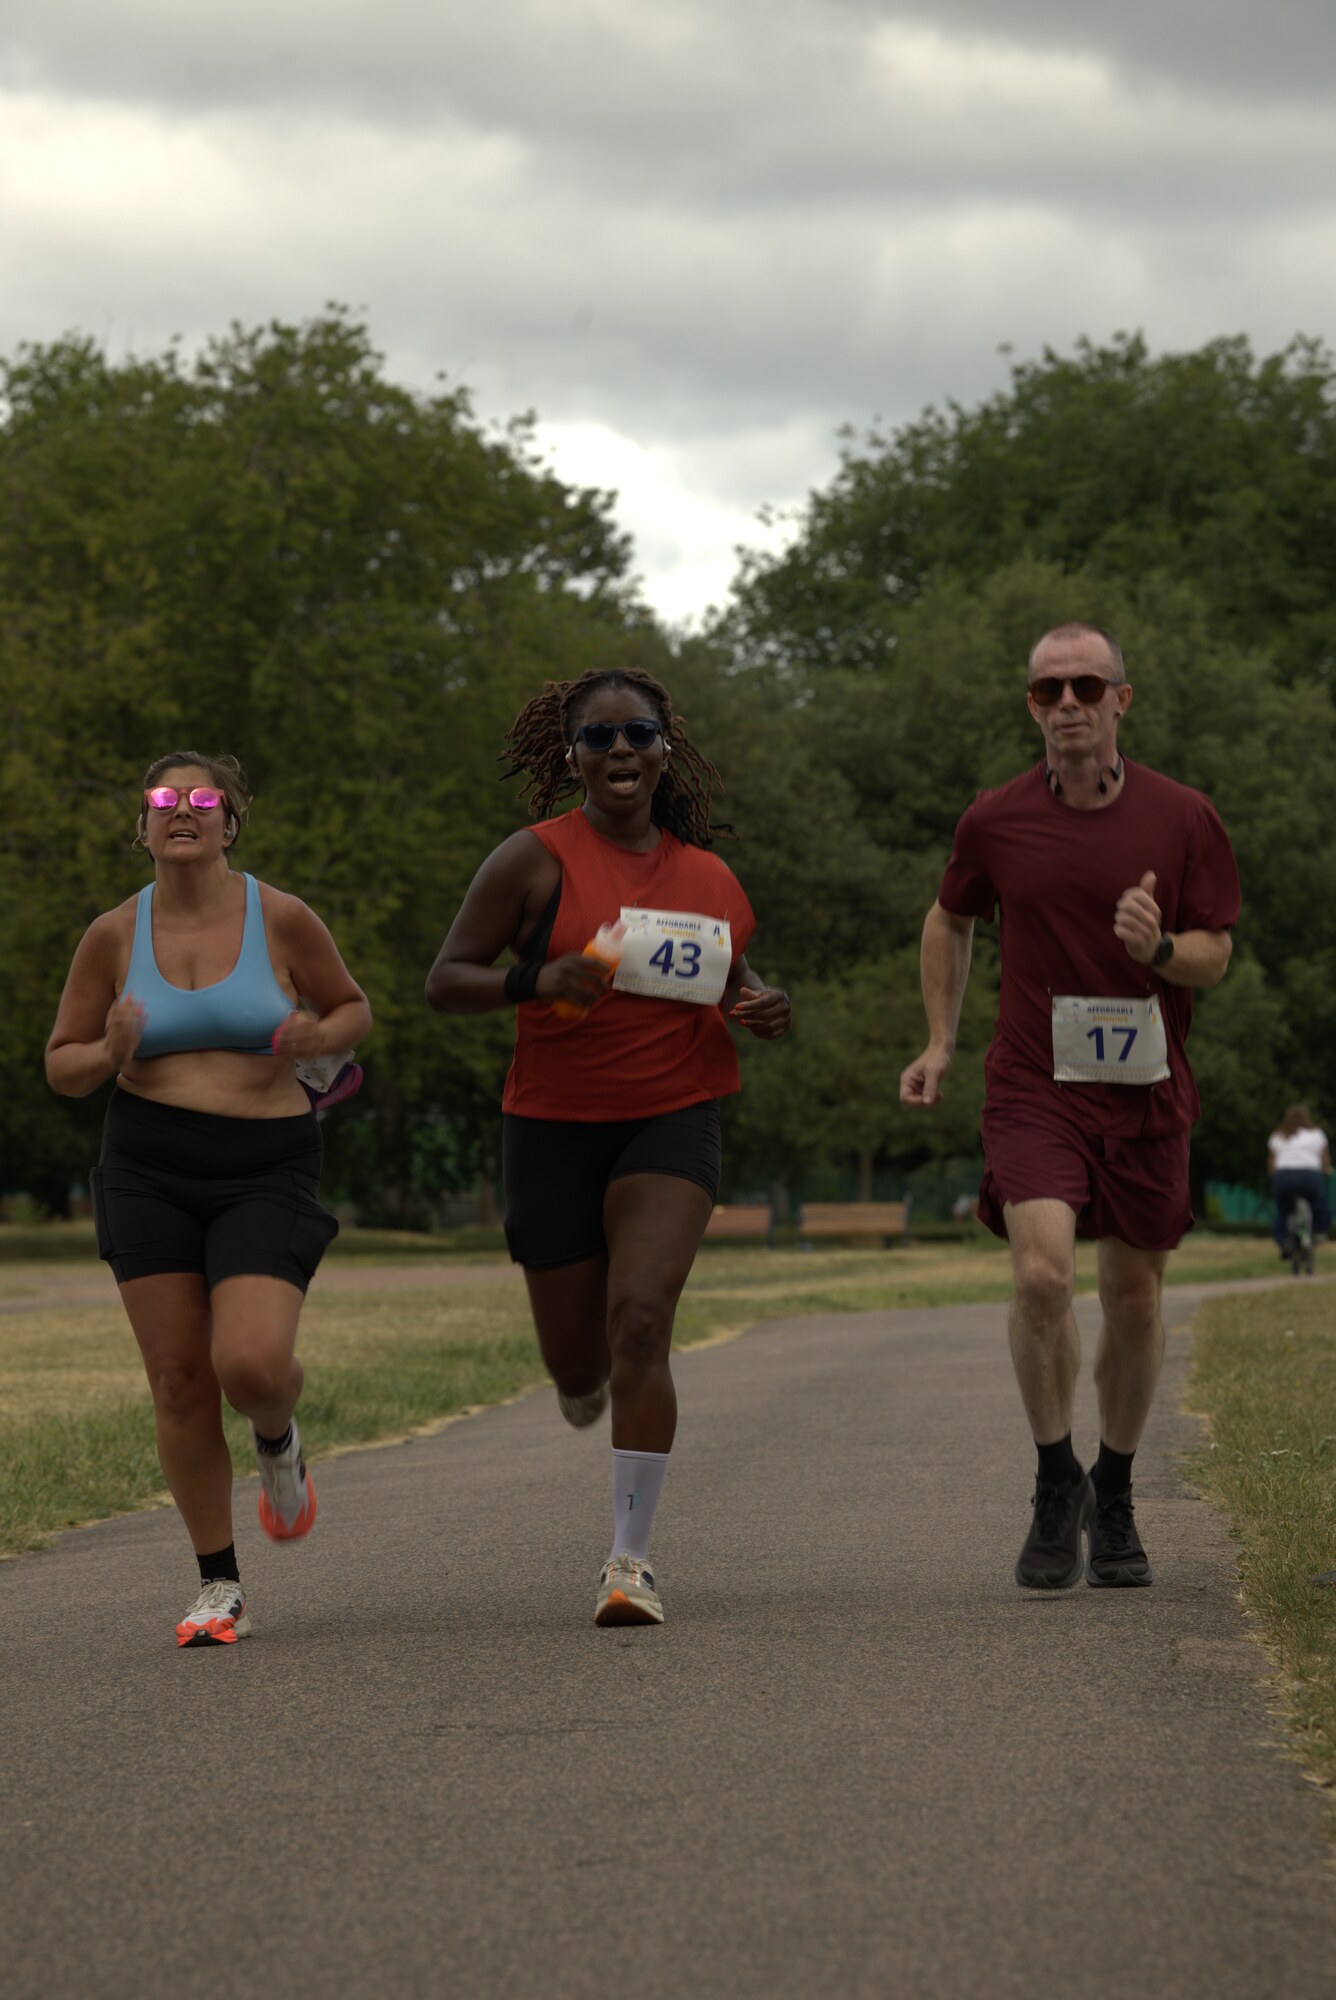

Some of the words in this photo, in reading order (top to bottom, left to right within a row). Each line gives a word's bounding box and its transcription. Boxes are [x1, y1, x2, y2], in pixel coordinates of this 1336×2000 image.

[656, 918, 701, 931] AFFORDABLE
[661, 928, 696, 939] RUNNING
[649, 938, 702, 979] 43
[1087, 1005, 1134, 1015] AFFORDABLE
[1087, 1026, 1138, 1062] 17
